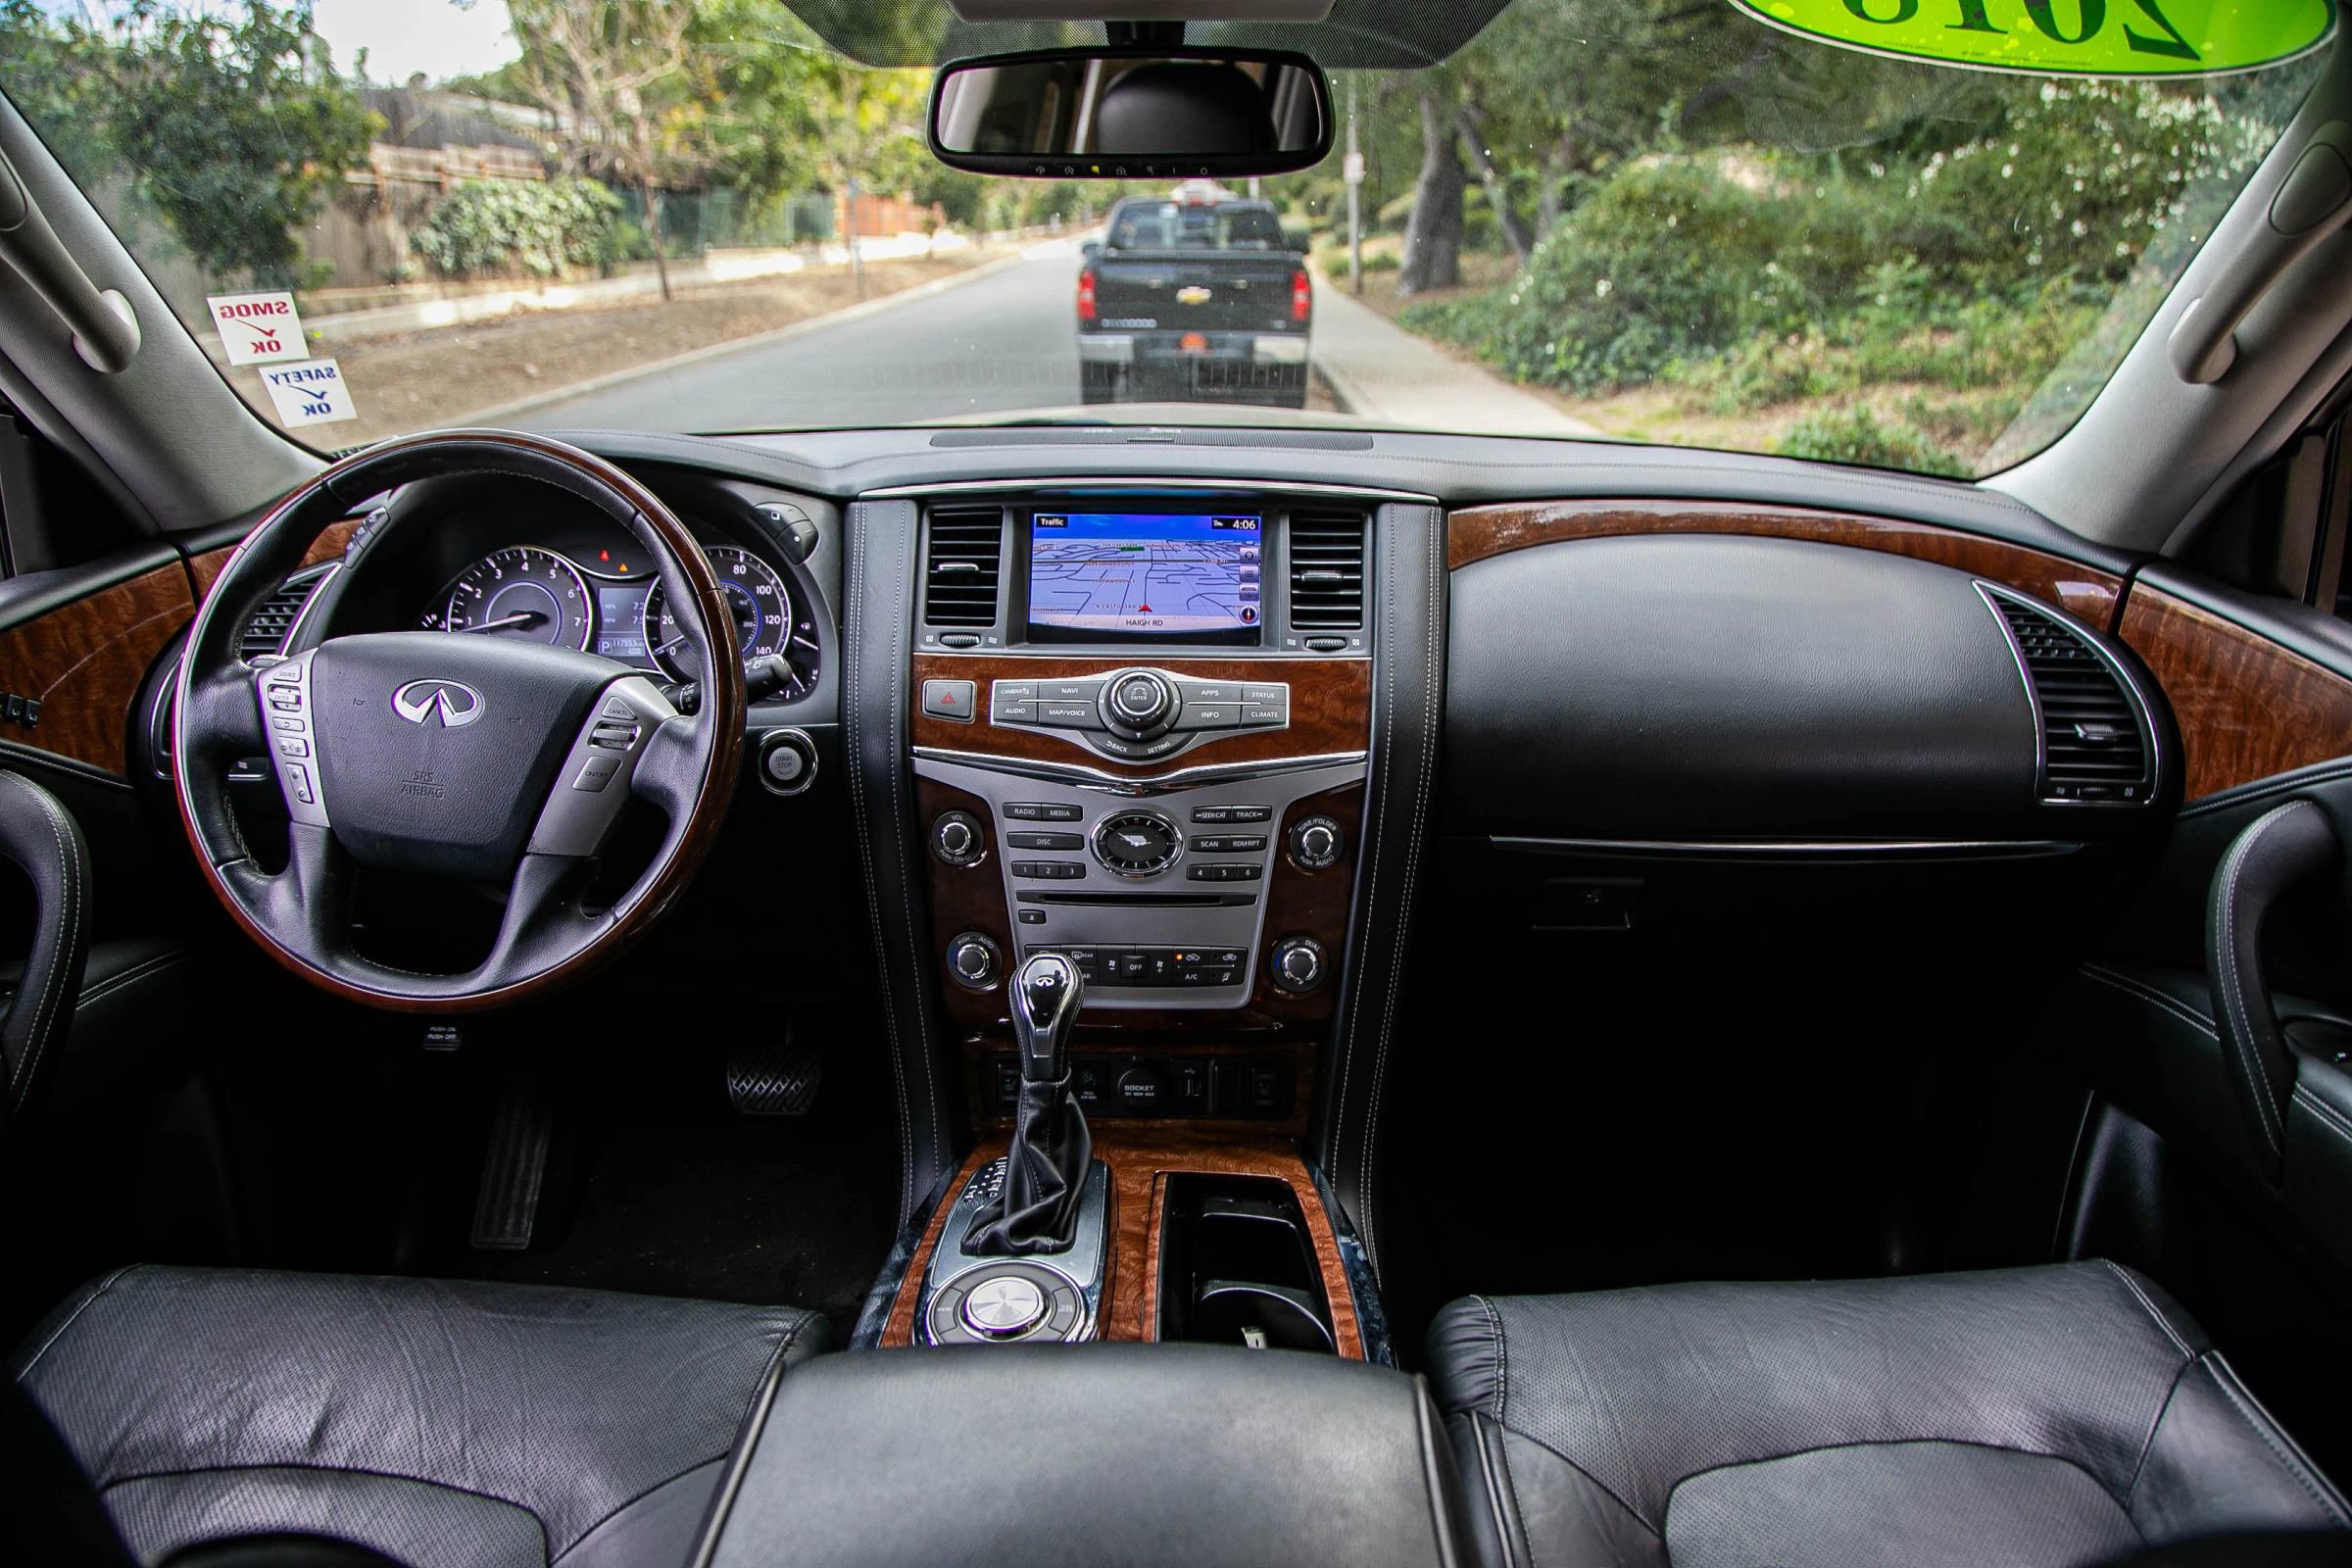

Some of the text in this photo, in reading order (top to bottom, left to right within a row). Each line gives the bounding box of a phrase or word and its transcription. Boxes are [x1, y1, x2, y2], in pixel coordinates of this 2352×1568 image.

[1040, 517, 1064, 526] Traffic
[1232, 519, 1256, 530] 4:06
[521, 562, 529, 571] 4
[733, 564, 747, 575] 80
[495, 568, 503, 579] 3
[549, 568, 557, 579] 5
[474, 588, 482, 599] 2
[567, 590, 575, 599] 6
[756, 585, 772, 595] 100
[466, 616, 472, 626] 1
[574, 616, 581, 626] 7
[662, 614, 675, 625] 20
[764, 614, 781, 625] 120
[601, 642, 611, 653] P
[669, 646, 676, 656] 0
[756, 646, 772, 656] 140
[1111, 742, 1128, 753] BACK
[1147, 741, 1171, 755] SETTING
[400, 784, 445, 799] AIRBAG
[1297, 817, 1337, 832] TUNE/FOLDER
[1299, 855, 1335, 866] PUSH AUDIO
[956, 936, 995, 950] PUSH AUTO
[1283, 939, 1321, 952] PUSH DUAL
